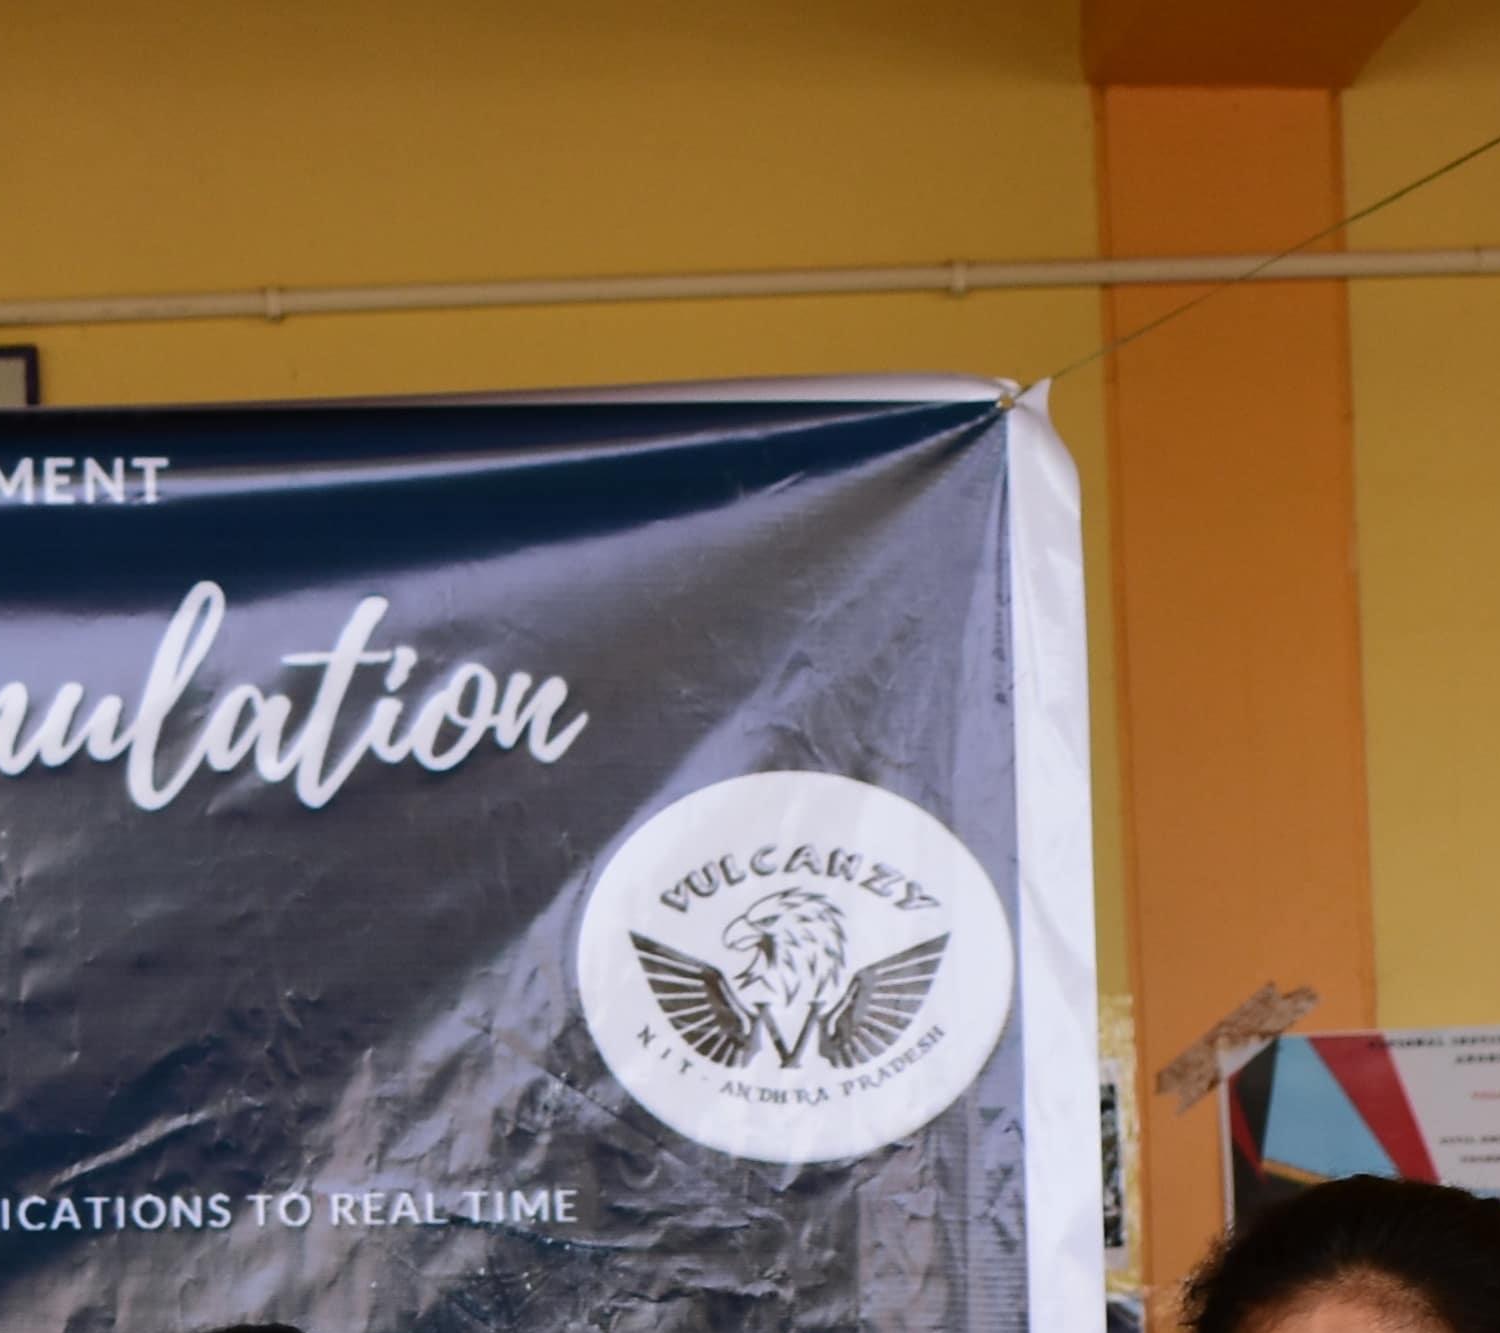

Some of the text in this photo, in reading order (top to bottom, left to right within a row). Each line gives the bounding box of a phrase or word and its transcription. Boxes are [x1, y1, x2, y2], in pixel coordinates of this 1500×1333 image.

[660, 844, 941, 913] VULCANZY
[636, 1024, 695, 1077] NIT
[720, 1080, 829, 1107] ANDHRA
[840, 1023, 946, 1098] PRADESH
[248, 1192, 312, 1229] TO
[330, 1190, 449, 1227] REAL
[454, 1188, 578, 1225] TIME
